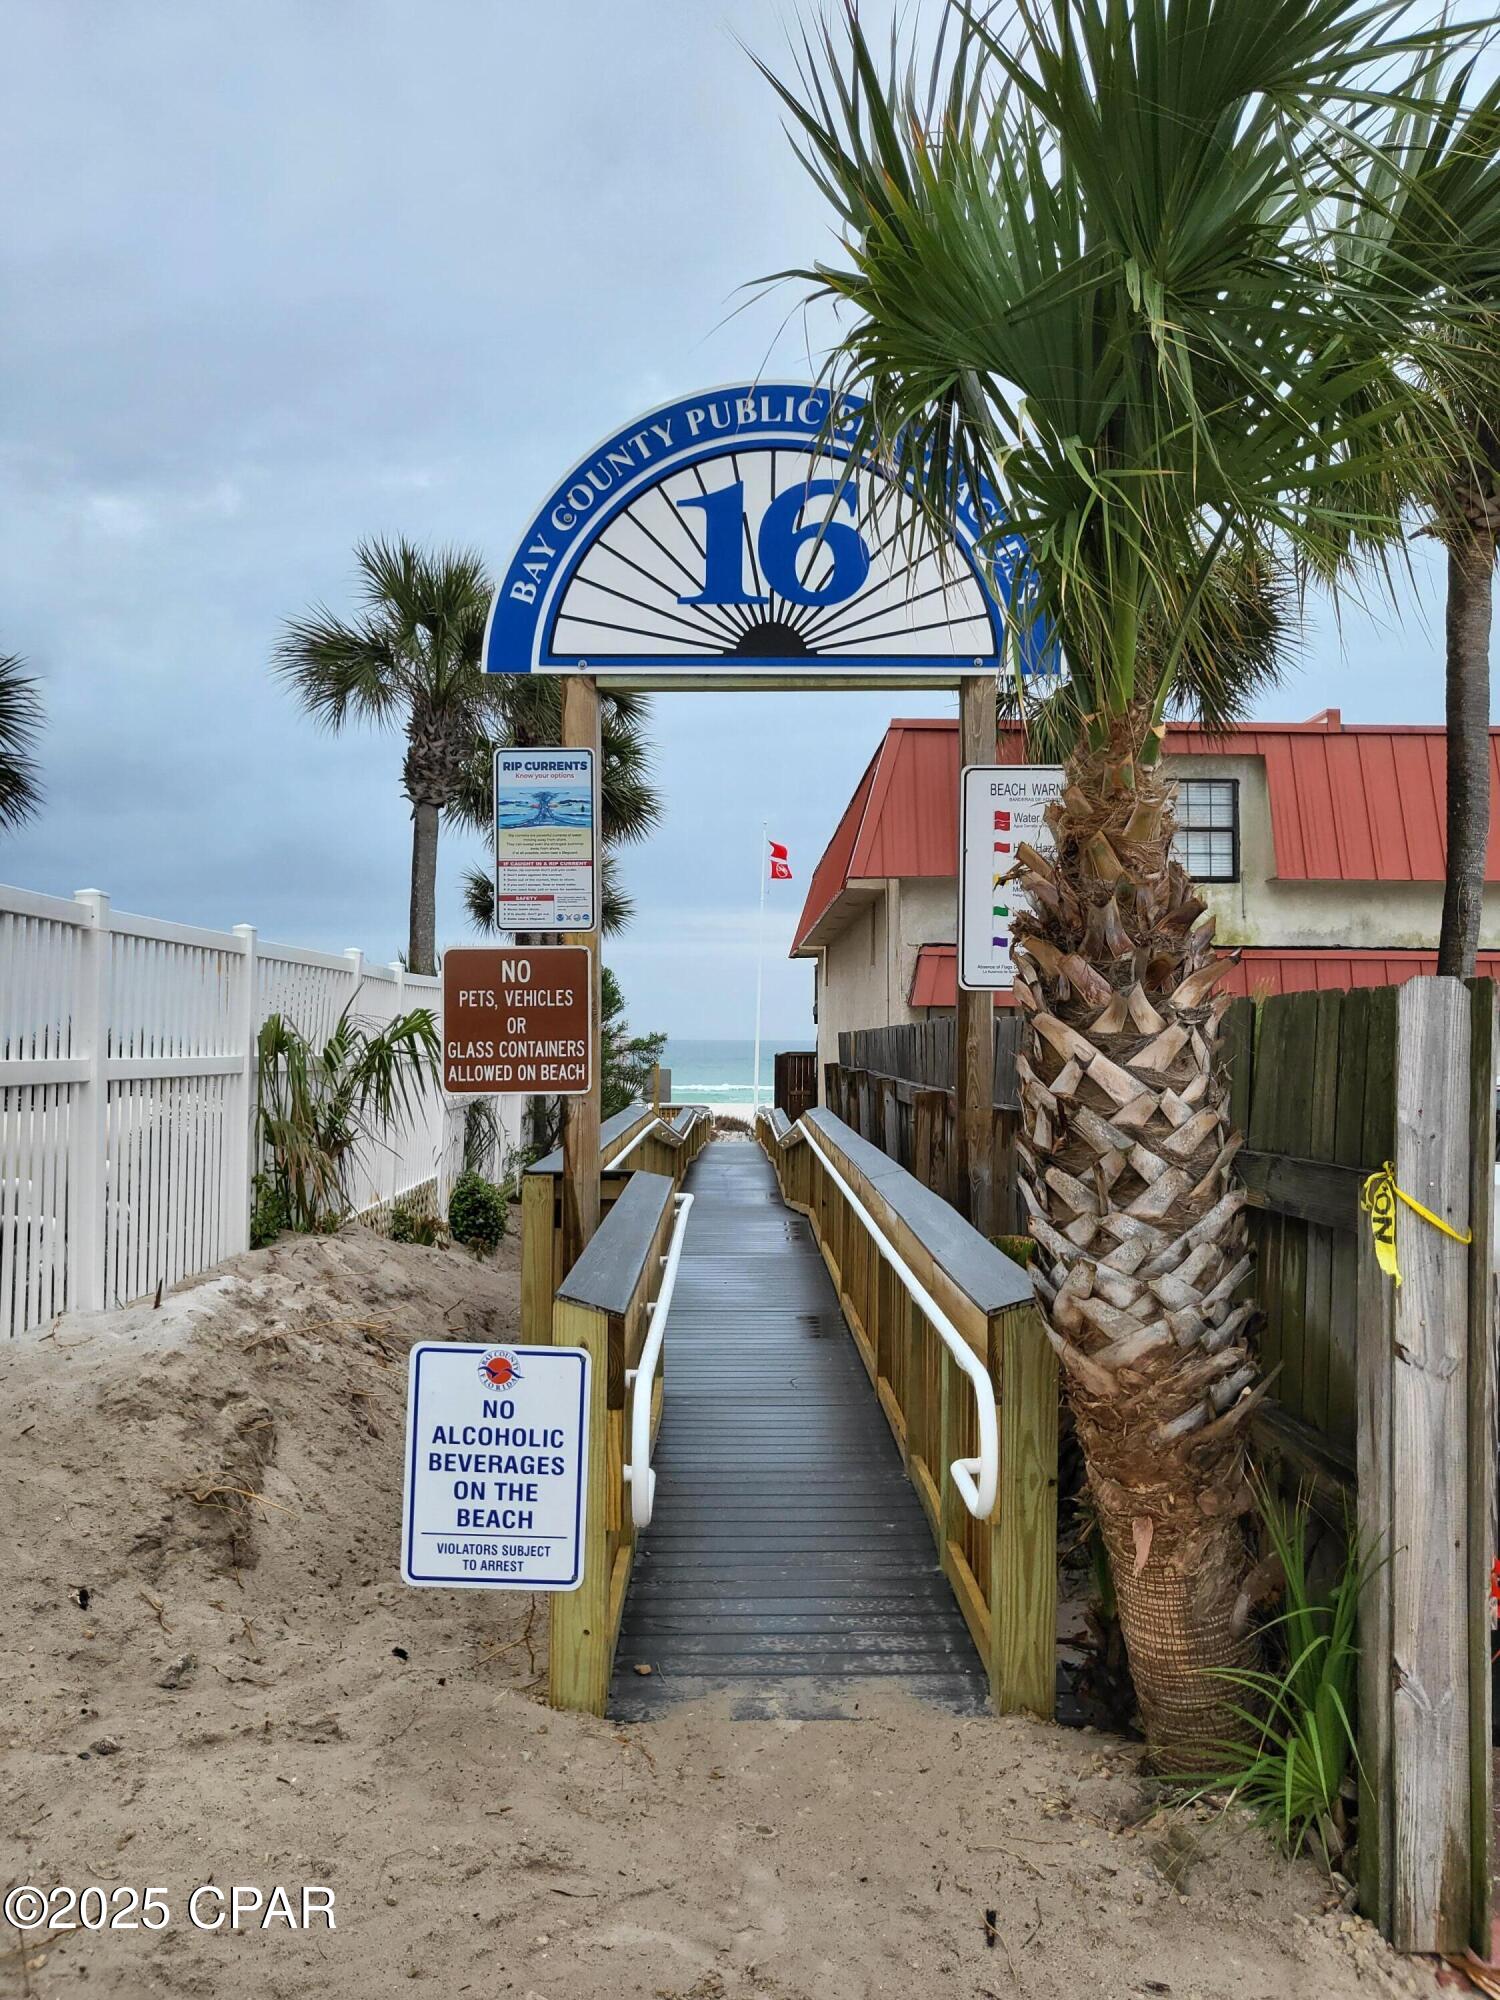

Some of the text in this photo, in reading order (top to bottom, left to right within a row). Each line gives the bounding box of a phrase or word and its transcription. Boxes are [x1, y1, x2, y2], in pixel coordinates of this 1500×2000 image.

[509, 532, 557, 605] BAY
[551, 418, 674, 532] COUNTY
[686, 395, 824, 436] PUBLIC
[676, 479, 870, 607] 16
[503, 761, 588, 771] RIP CURRENTS
[550, 772, 575, 780] options
[990, 783, 1066, 796] BEACH WARN
[1013, 812, 1041, 823] Water
[501, 959, 531, 983] NO
[459, 989, 574, 1010] PETS, VEHICLES
[507, 1017, 526, 1034] OR
[448, 1040, 585, 1059] GLASS CONTAINERS
[448, 1064, 585, 1082] ALLOWED ON BEACH
[483, 1400, 515, 1419] NO
[432, 1426, 564, 1448] ALCOHOLIC
[428, 1453, 565, 1476] BEVERAGES
[453, 1481, 538, 1502] ON THE
[457, 1508, 533, 1529] BEACH
[436, 1542, 551, 1557] VIOLATORS SUBJECT
[462, 1559, 524, 1572] TO ARREST
